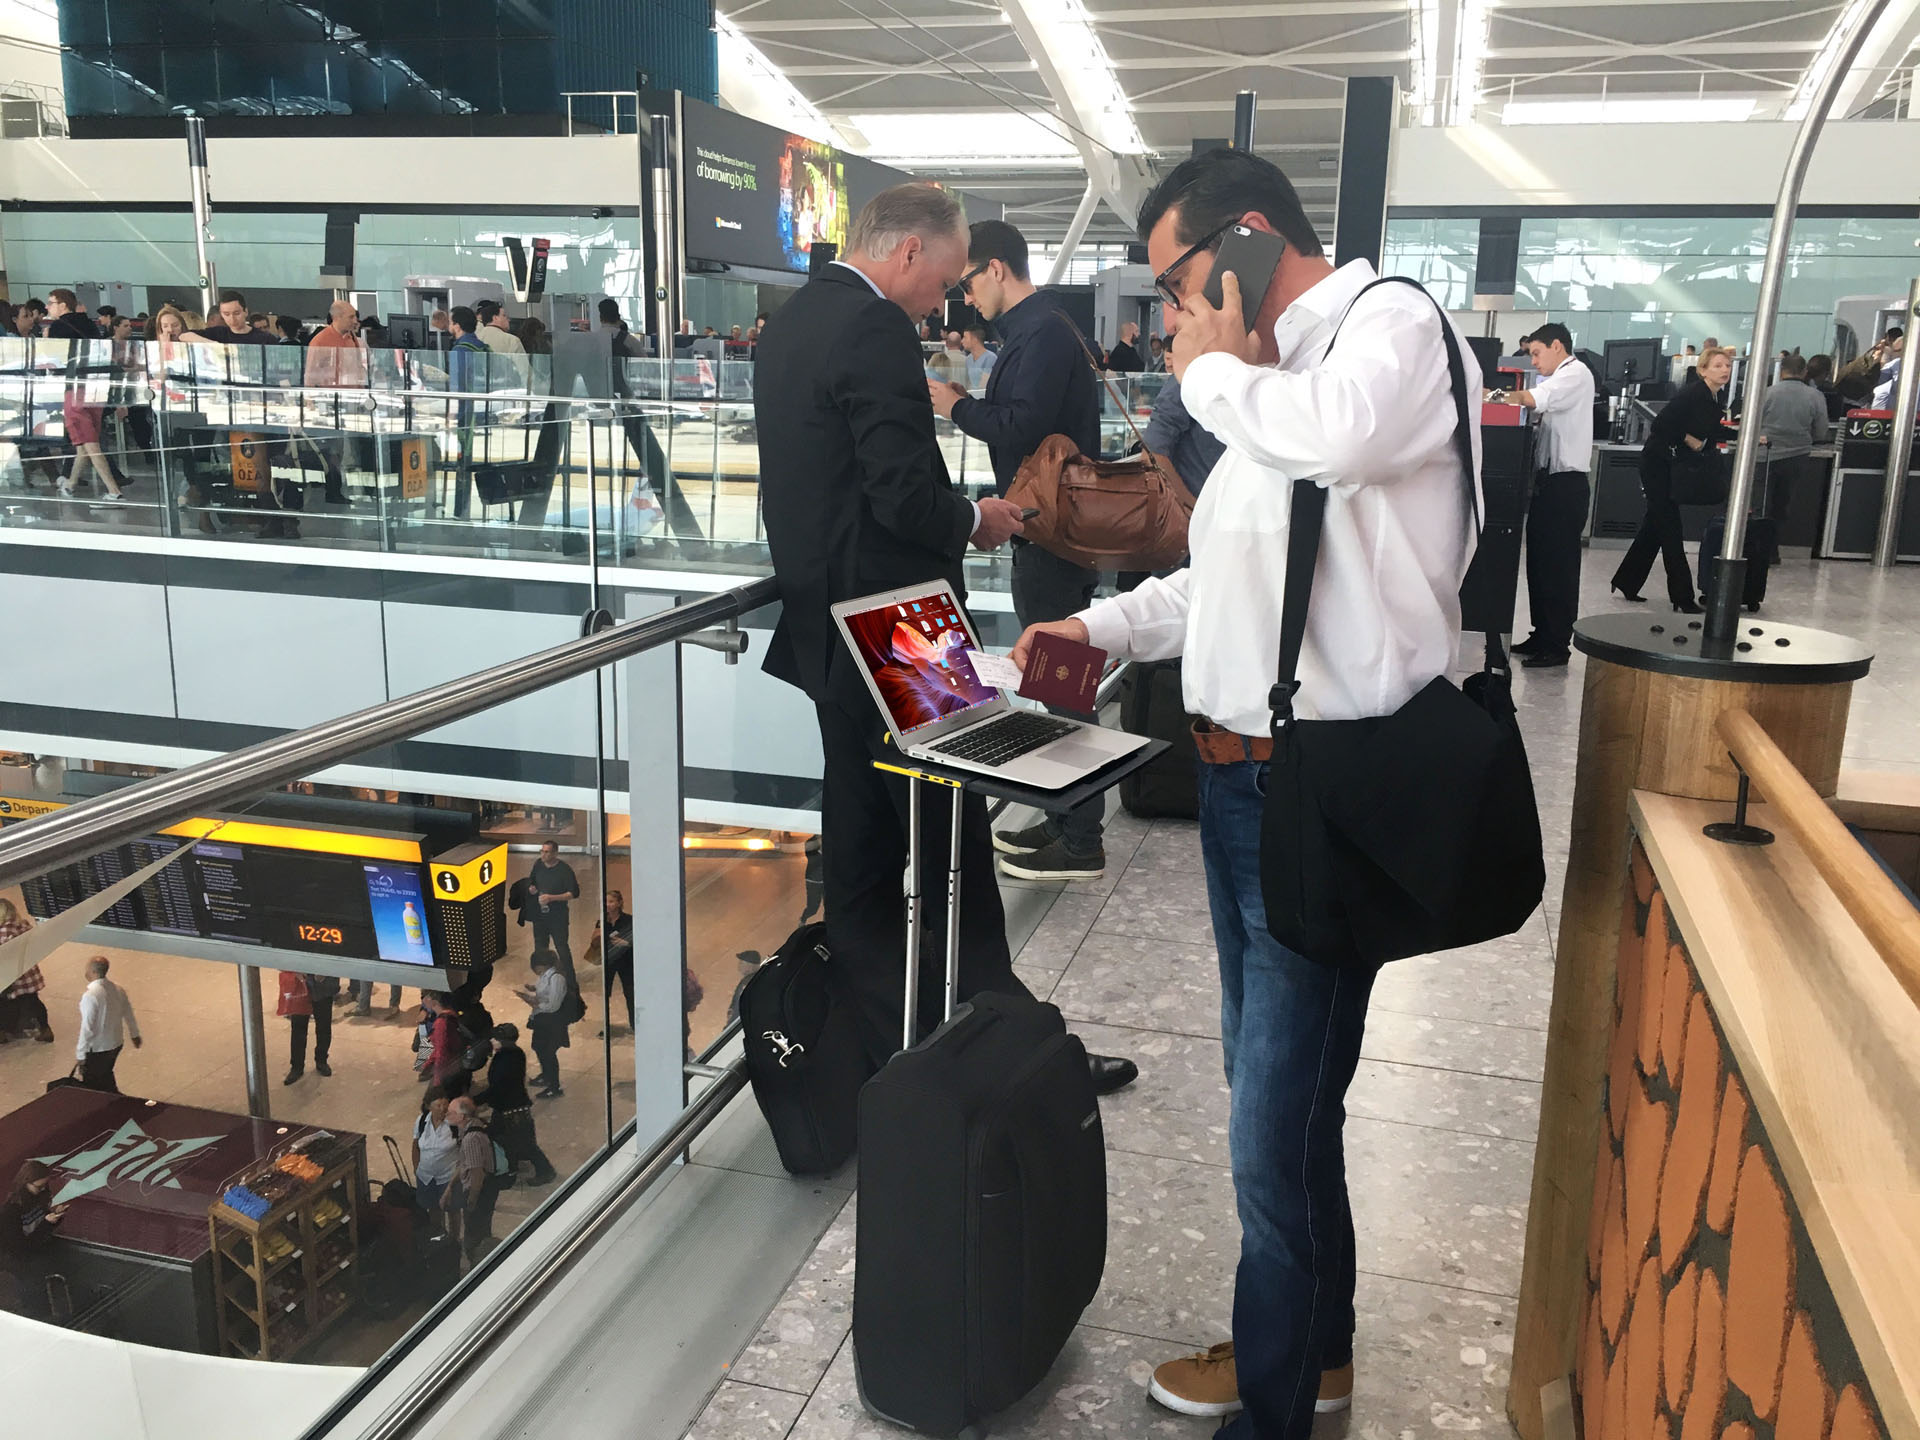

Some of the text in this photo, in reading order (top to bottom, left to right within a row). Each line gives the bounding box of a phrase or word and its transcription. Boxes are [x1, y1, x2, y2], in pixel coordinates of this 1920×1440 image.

[697, 161, 704, 177] of
[704, 162, 735, 189] borrowing
[735, 171, 743, 191] by
[13, 802, 56, 815] Depart
[299, 925, 342, 944] 12:29
[48, 1129, 218, 1197] PRET
